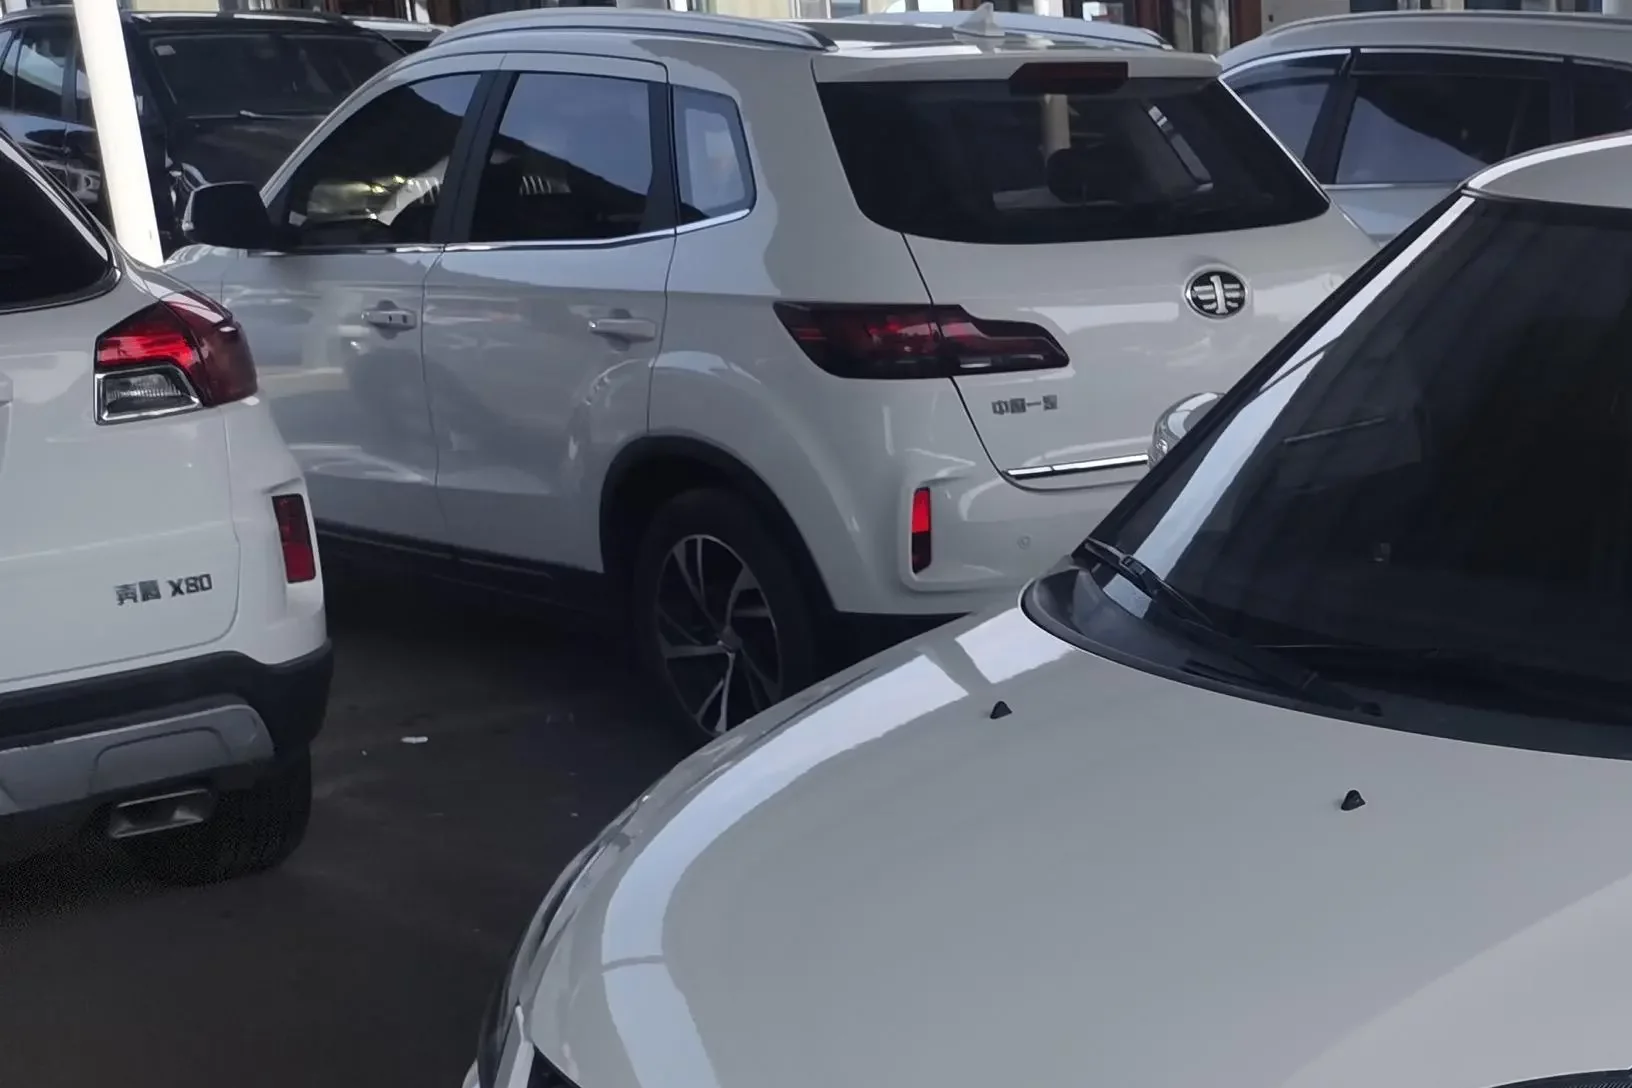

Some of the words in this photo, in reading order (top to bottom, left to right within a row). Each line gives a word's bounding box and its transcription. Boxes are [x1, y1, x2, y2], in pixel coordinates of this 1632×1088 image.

[991, 394, 1058, 416] 中一
[114, 580, 161, 606] 奔
[167, 573, 213, 597] X80
